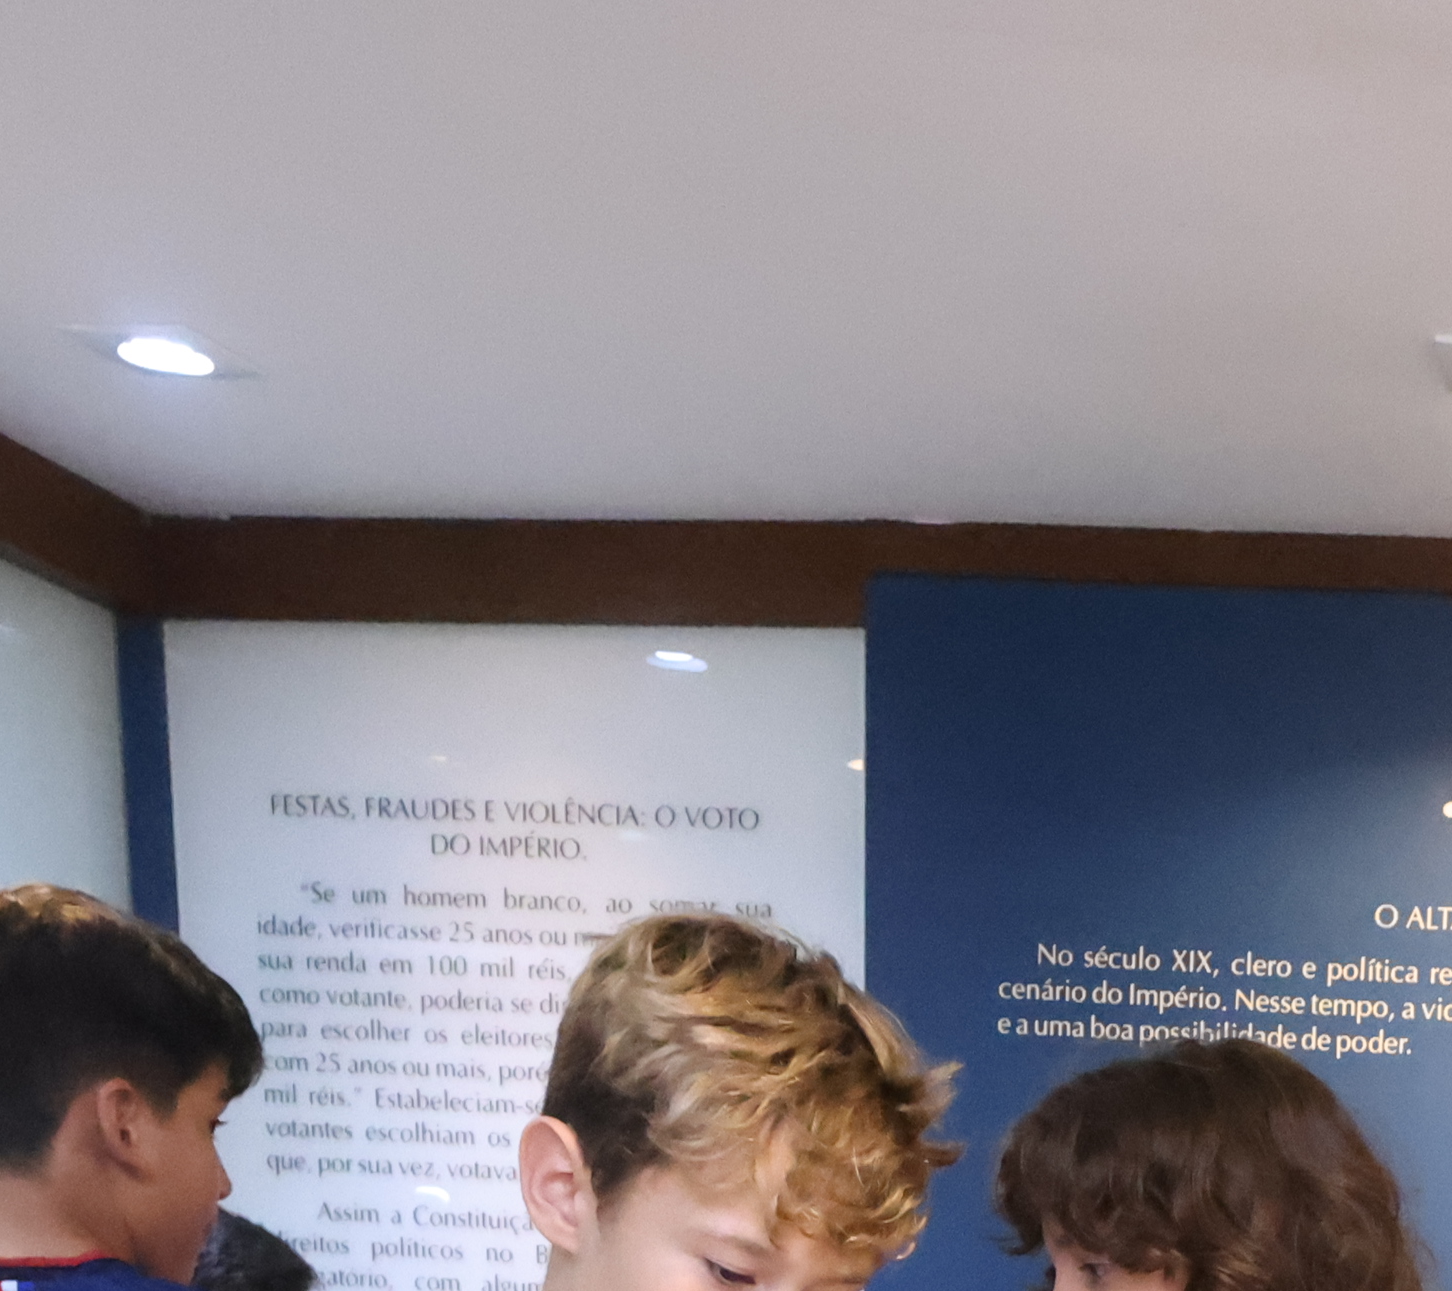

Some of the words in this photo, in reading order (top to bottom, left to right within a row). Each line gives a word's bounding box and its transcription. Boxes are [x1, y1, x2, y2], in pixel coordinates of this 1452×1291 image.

[269, 794, 356, 820] FESTAS,
[364, 796, 476, 821] FRAUDES
[504, 797, 646, 827] VIOLÊNCIA:
[655, 804, 676, 829] O
[685, 806, 760, 831] VOTO
[431, 833, 471, 856] DO
[479, 830, 587, 861] IMPÉRIO.
[351, 887, 387, 905] um
[403, 884, 487, 909] homem
[503, 886, 587, 914] branco,
[606, 897, 633, 914] ao
[257, 914, 322, 941] idade,
[329, 919, 442, 942] verificasse
[448, 922, 475, 943] 25
[482, 926, 534, 946] anos
[539, 928, 566, 946] ou
[1374, 904, 1398, 929] O
[257, 952, 293, 972] sua
[305, 950, 367, 974] renda
[379, 957, 412, 975] em
[428, 955, 467, 976] 100
[480, 955, 515, 979] mil
[1037, 943, 1074, 967] No
[1083, 945, 1161, 972] século
[1171, 949, 1220, 978] XIX,
[1230, 951, 1292, 979] clero
[1301, 961, 1317, 979] e
[1326, 956, 1419, 987] política
[259, 988, 320, 1007] como
[326, 989, 413, 1010] votante,
[420, 991, 504, 1015] poderia
[511, 995, 534, 1013] se
[997, 978, 1087, 1004] cenário
[1091, 980, 1123, 1006] do
[1129, 983, 1228, 1014] Império.
[1234, 988, 1306, 1016] Nesse
[1310, 994, 1395, 1025] tempo,
[1401, 1002, 1415, 1020] a
[260, 1019, 308, 1041] para
[320, 1018, 411, 1043] escolher
[461, 1022, 553, 1048] eleitores
[997, 1016, 1012, 1035] e
[1015, 1018, 1029, 1035] a
[1034, 1019, 1085, 1038] uma
[1090, 1014, 1134, 1042] boa
[1301, 1026, 1332, 1052] de
[1335, 1029, 1412, 1060] poder.
[315, 1053, 341, 1073] 25
[348, 1057, 397, 1076] anos
[403, 1060, 430, 1077] ou
[436, 1058, 491, 1080] mais,
[264, 1084, 298, 1104] mil
[266, 1120, 353, 1140] votantes
[365, 1121, 475, 1146] escolhiam
[487, 1131, 511, 1148] os
[317, 1157, 352, 1178] por
[357, 1158, 393, 1175] sua
[317, 1202, 380, 1224] Assim
[371, 1239, 463, 1262] políticos
[486, 1247, 514, 1263] no
